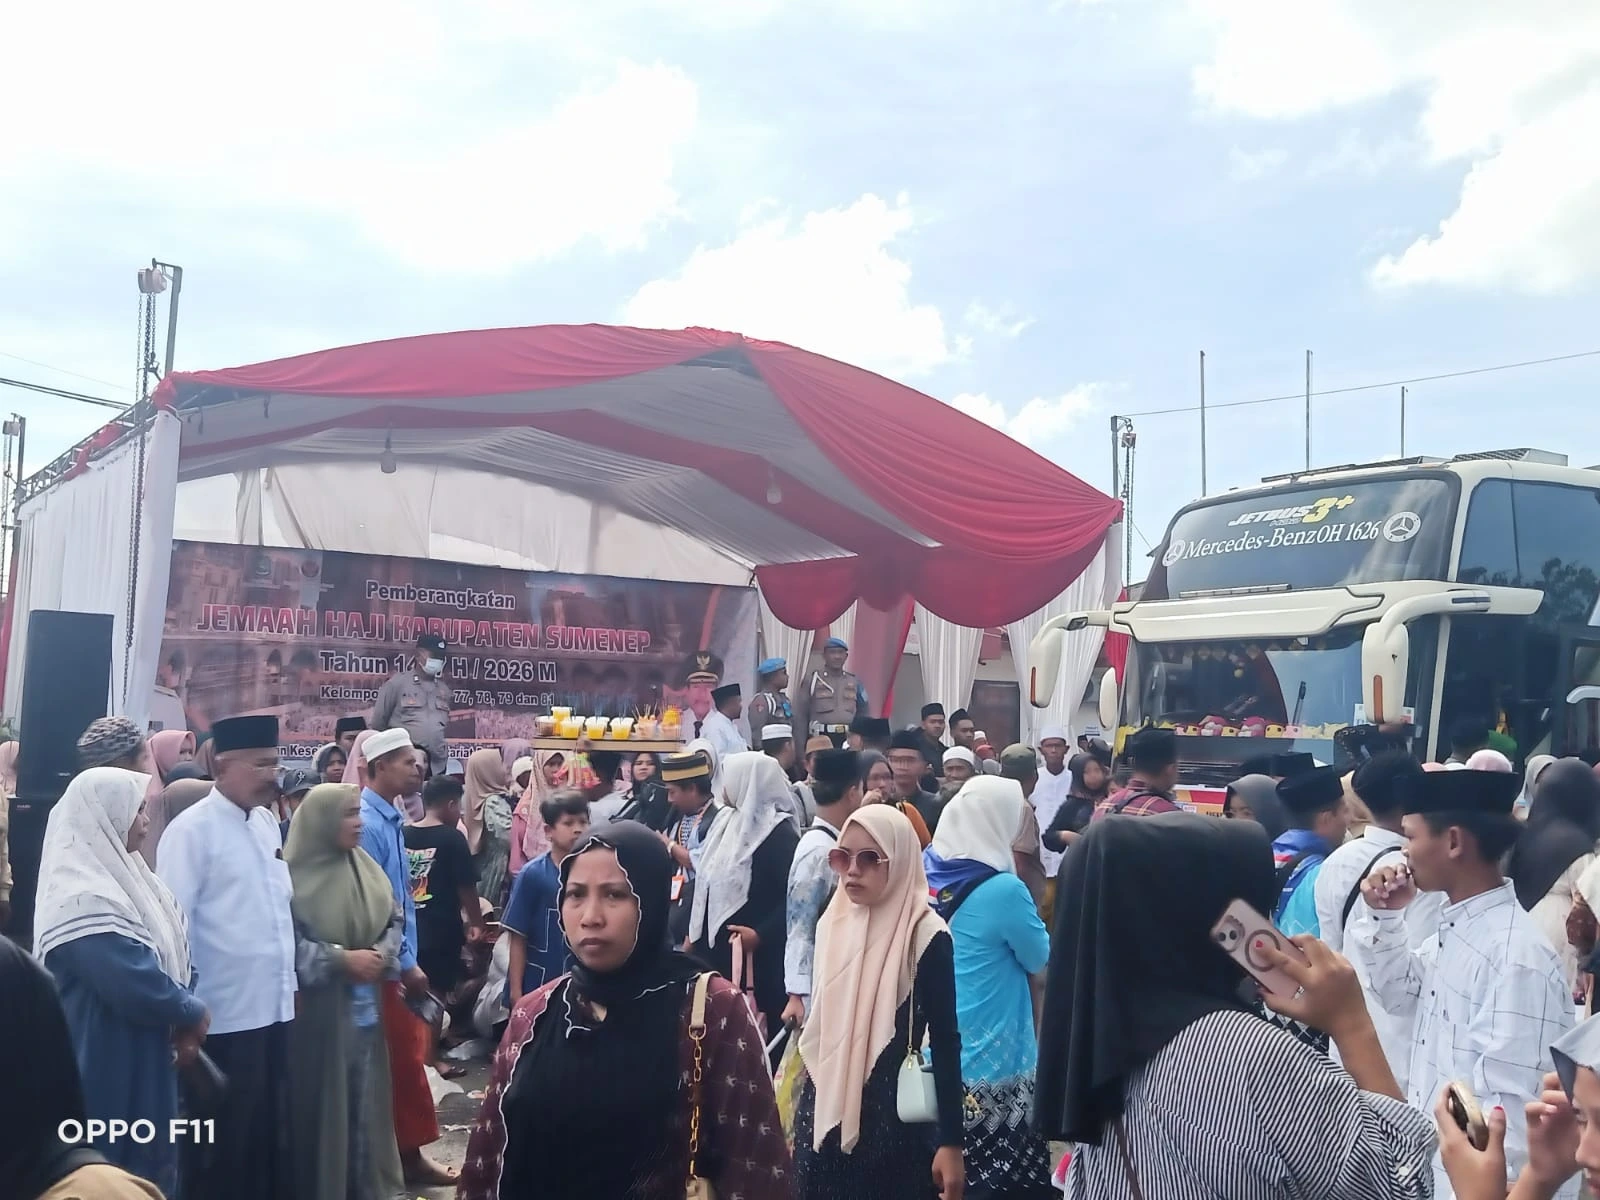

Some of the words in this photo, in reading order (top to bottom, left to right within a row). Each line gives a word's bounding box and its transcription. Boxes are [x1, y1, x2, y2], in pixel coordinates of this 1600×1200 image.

[1345, 521, 1382, 543] 1626
[367, 580, 515, 609] Pemberangkatan
[197, 604, 317, 636] JEMAAH
[325, 611, 385, 641] HAJI
[393, 615, 540, 649] KABUPATEN
[546, 625, 650, 653] SUMENEP
[319, 650, 389, 675] Tahun
[451, 656, 468, 679] H
[484, 658, 535, 682] 2026
[537, 660, 557, 683] M
[319, 685, 379, 702] Kelompo
[475, 691, 496, 706] 78,
[497, 691, 514, 705] 79
[515, 692, 539, 706] dan
